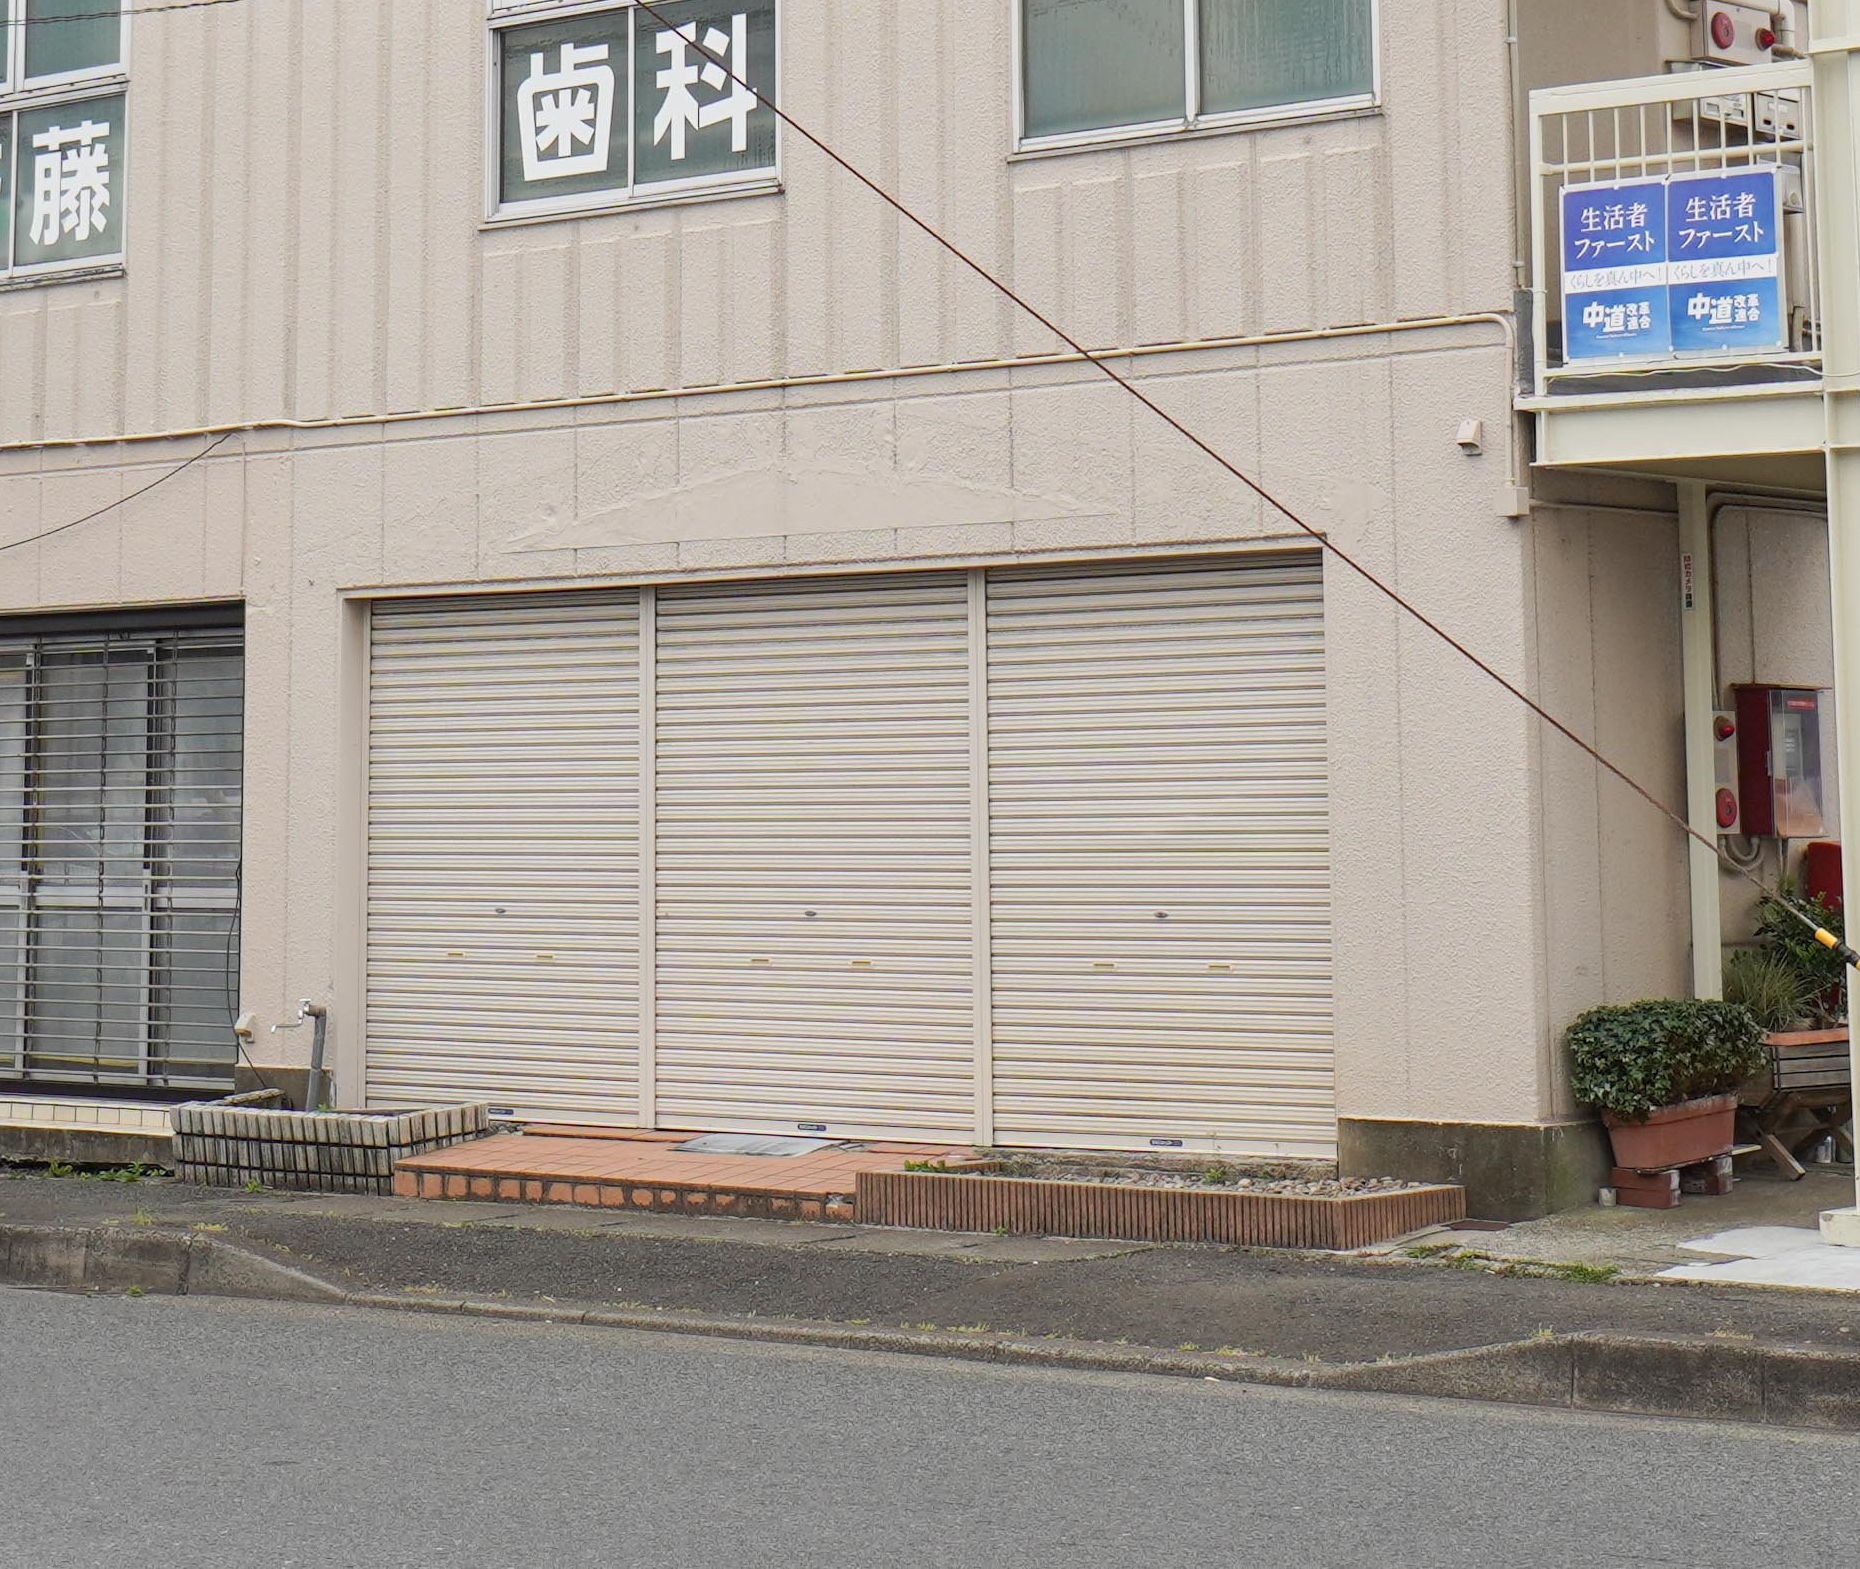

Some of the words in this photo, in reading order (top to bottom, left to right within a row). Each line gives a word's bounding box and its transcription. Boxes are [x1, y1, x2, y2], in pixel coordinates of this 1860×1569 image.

[517, 13, 758, 183] 歯科
[1580, 202, 1648, 233] 生活者
[1685, 192, 1757, 222] 生活者
[1574, 231, 1656, 261] ファースト
[1678, 221, 1765, 250] ファースト
